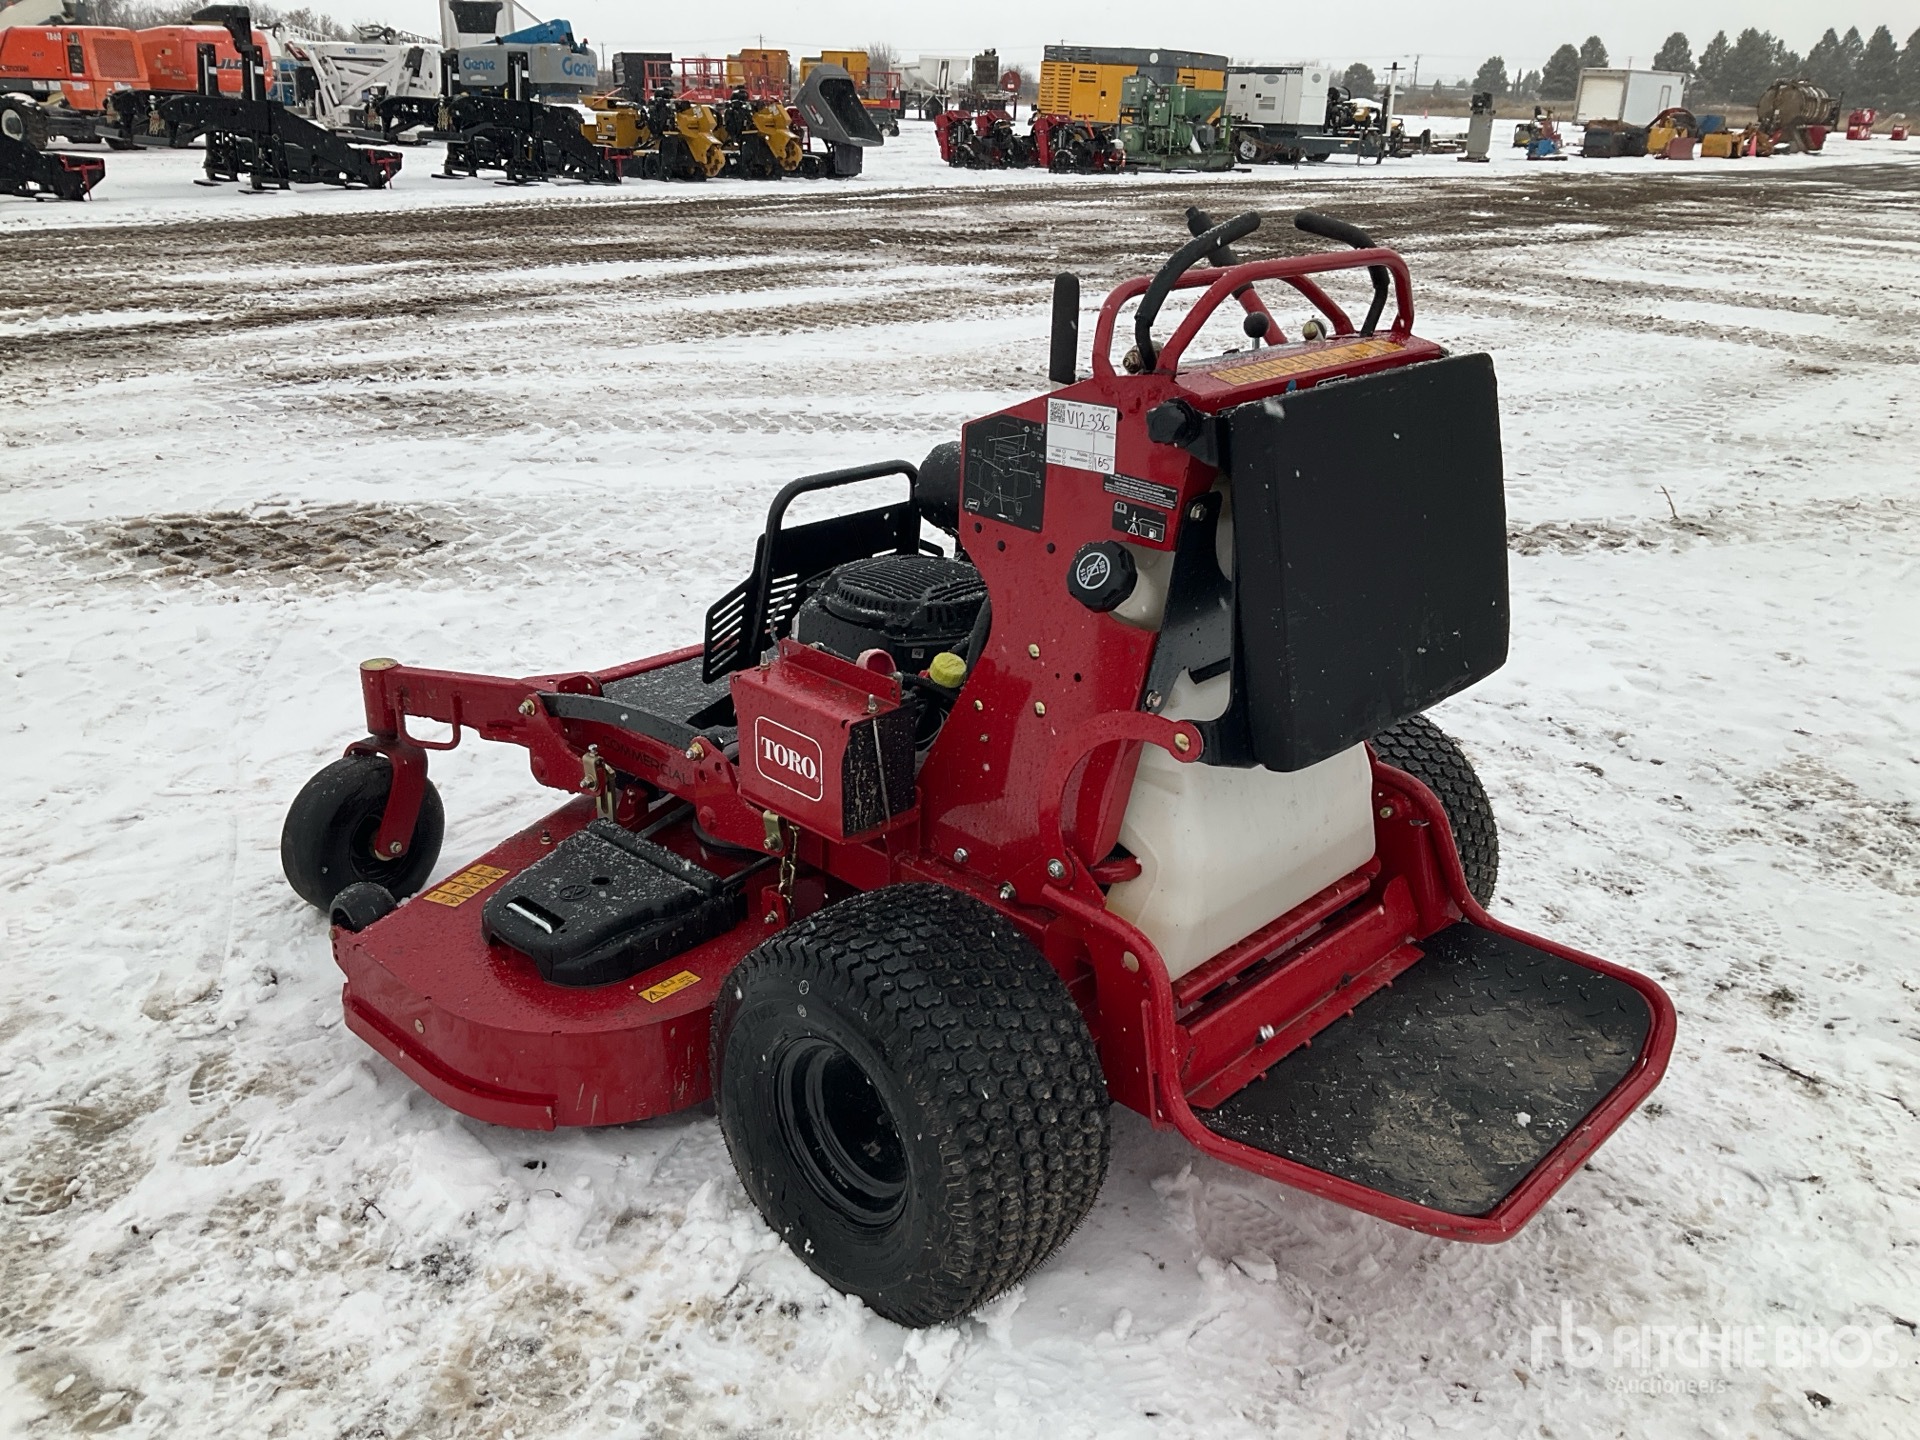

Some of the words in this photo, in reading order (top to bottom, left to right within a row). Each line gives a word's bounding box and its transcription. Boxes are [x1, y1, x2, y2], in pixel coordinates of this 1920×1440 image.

[463, 57, 495, 70] Genie
[562, 56, 596, 78] Genie
[1094, 457, 1110, 471] 165
[761, 736, 817, 779] TORO
